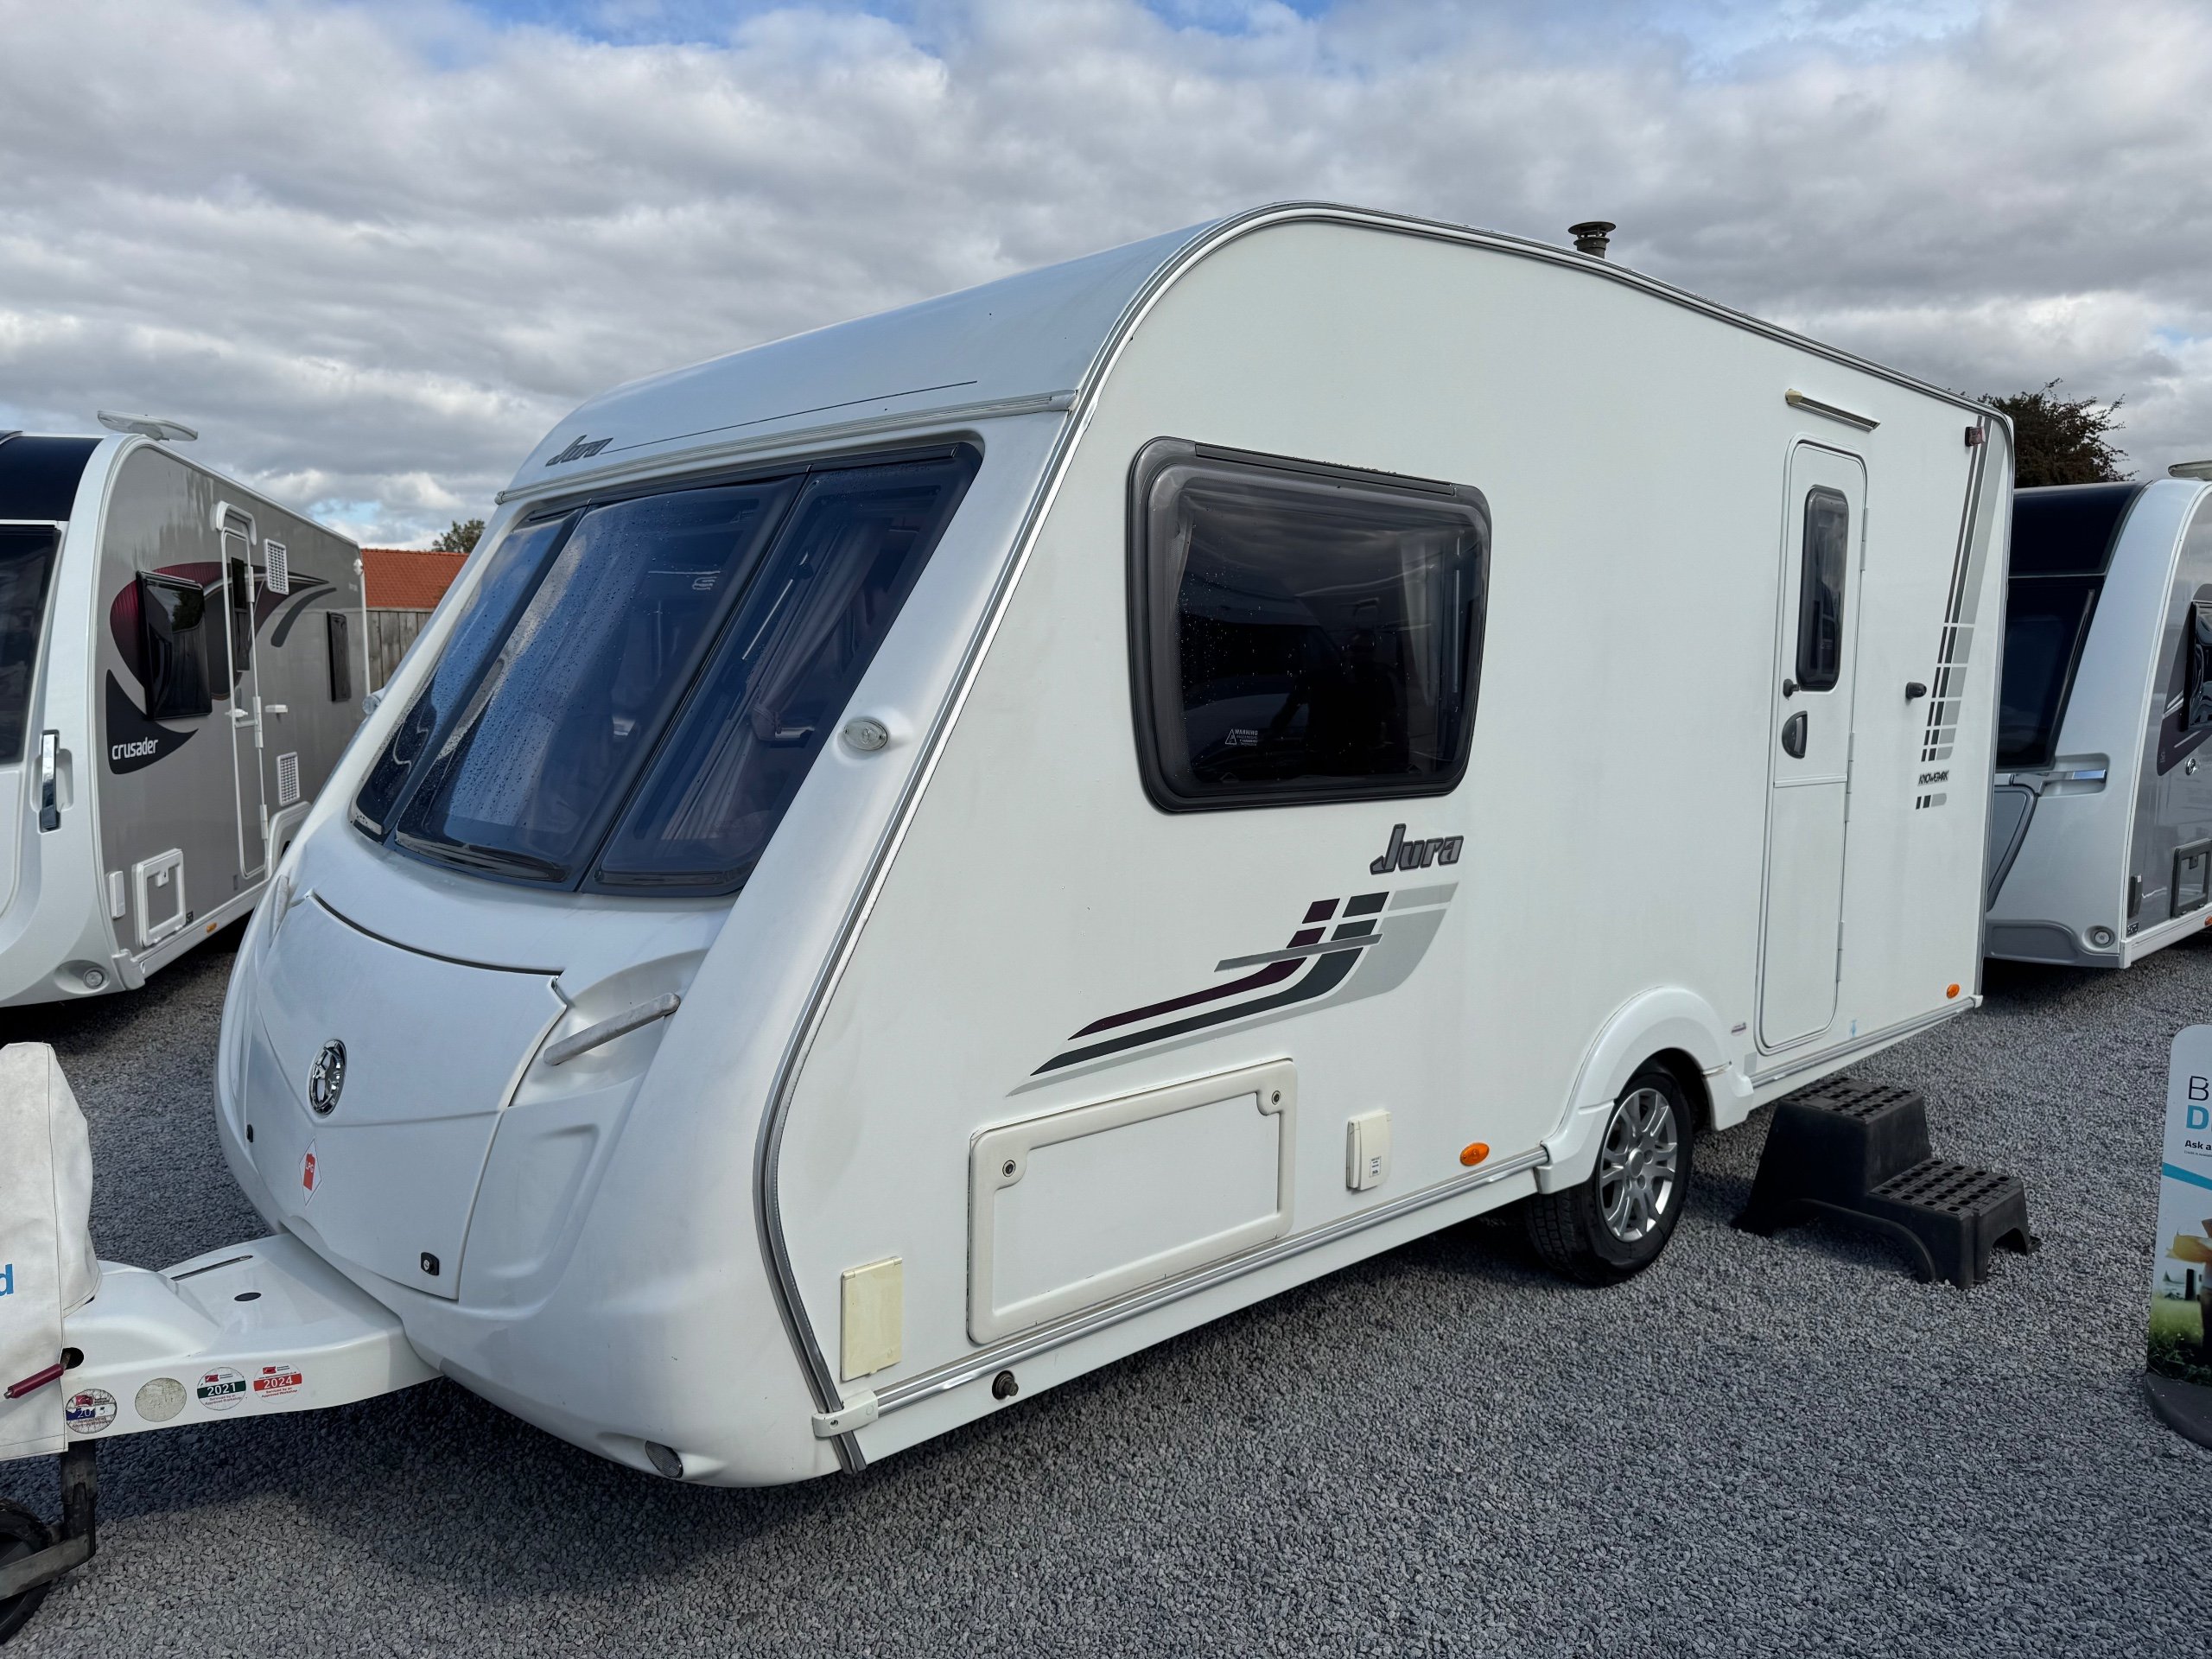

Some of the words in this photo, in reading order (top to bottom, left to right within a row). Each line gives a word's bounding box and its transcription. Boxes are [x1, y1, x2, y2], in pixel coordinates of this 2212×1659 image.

[111, 736, 159, 760] crusader
[1370, 823, 1464, 875] Jura
[2186, 1105, 2212, 1130] D
[2184, 1140, 2203, 1150] Ask
[207, 1382, 236, 1396] 2021
[263, 1376, 293, 1389] 2024
